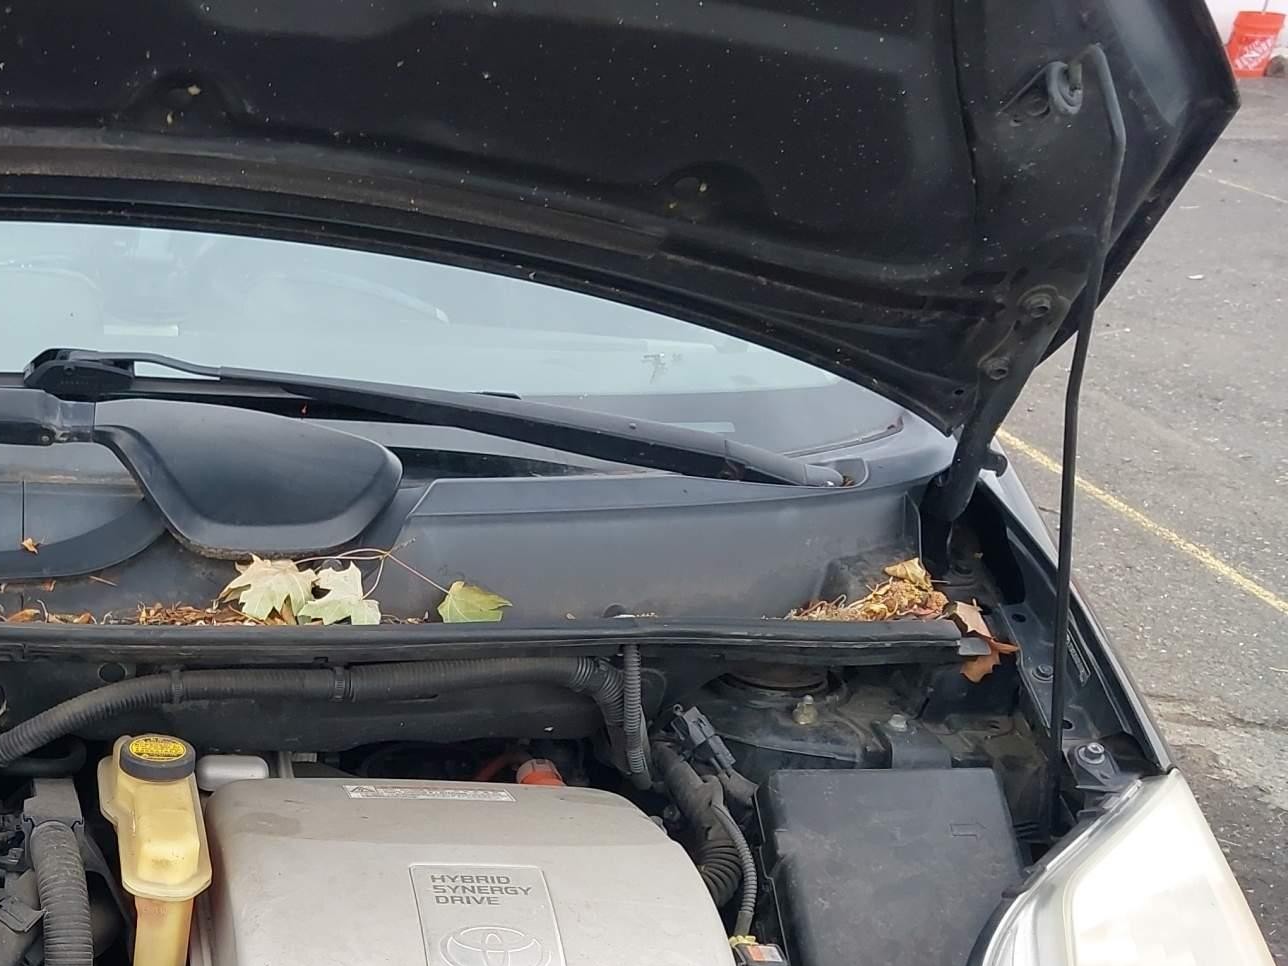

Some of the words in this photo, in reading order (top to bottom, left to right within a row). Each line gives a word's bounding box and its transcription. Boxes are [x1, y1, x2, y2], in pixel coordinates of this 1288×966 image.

[430, 874, 511, 885] HYBRID
[431, 885, 532, 896] SYNERGY
[435, 895, 501, 906] DRIVE
